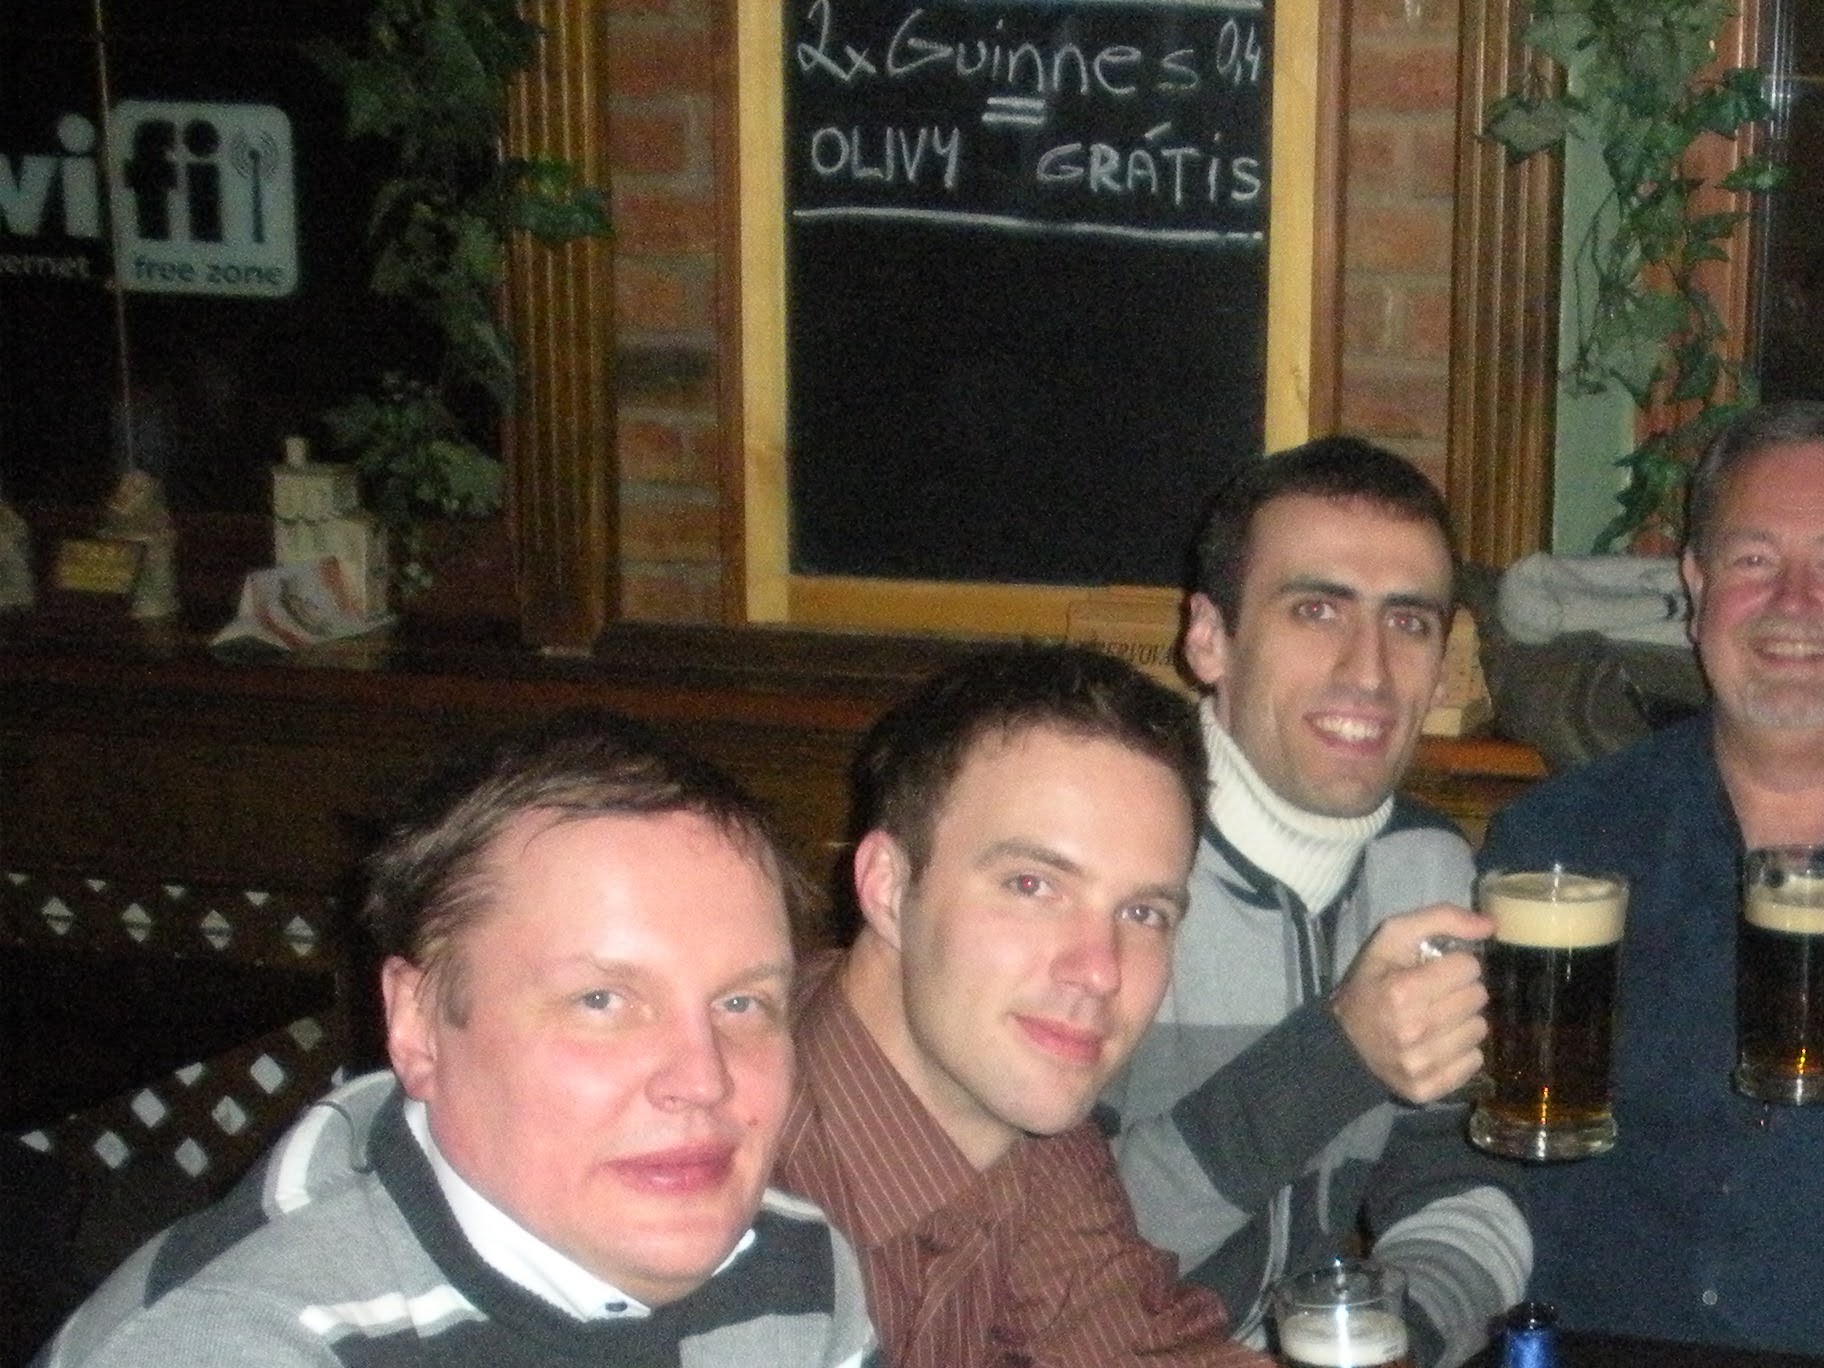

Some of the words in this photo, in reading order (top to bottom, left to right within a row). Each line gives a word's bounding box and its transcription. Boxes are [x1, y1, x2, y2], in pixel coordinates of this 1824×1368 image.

[799, 0, 877, 82] 2x
[887, 9, 1200, 96] Guinnes
[811, 126, 960, 190] OLIVY
[134, 259, 196, 283] free
[206, 263, 283, 284] zone
